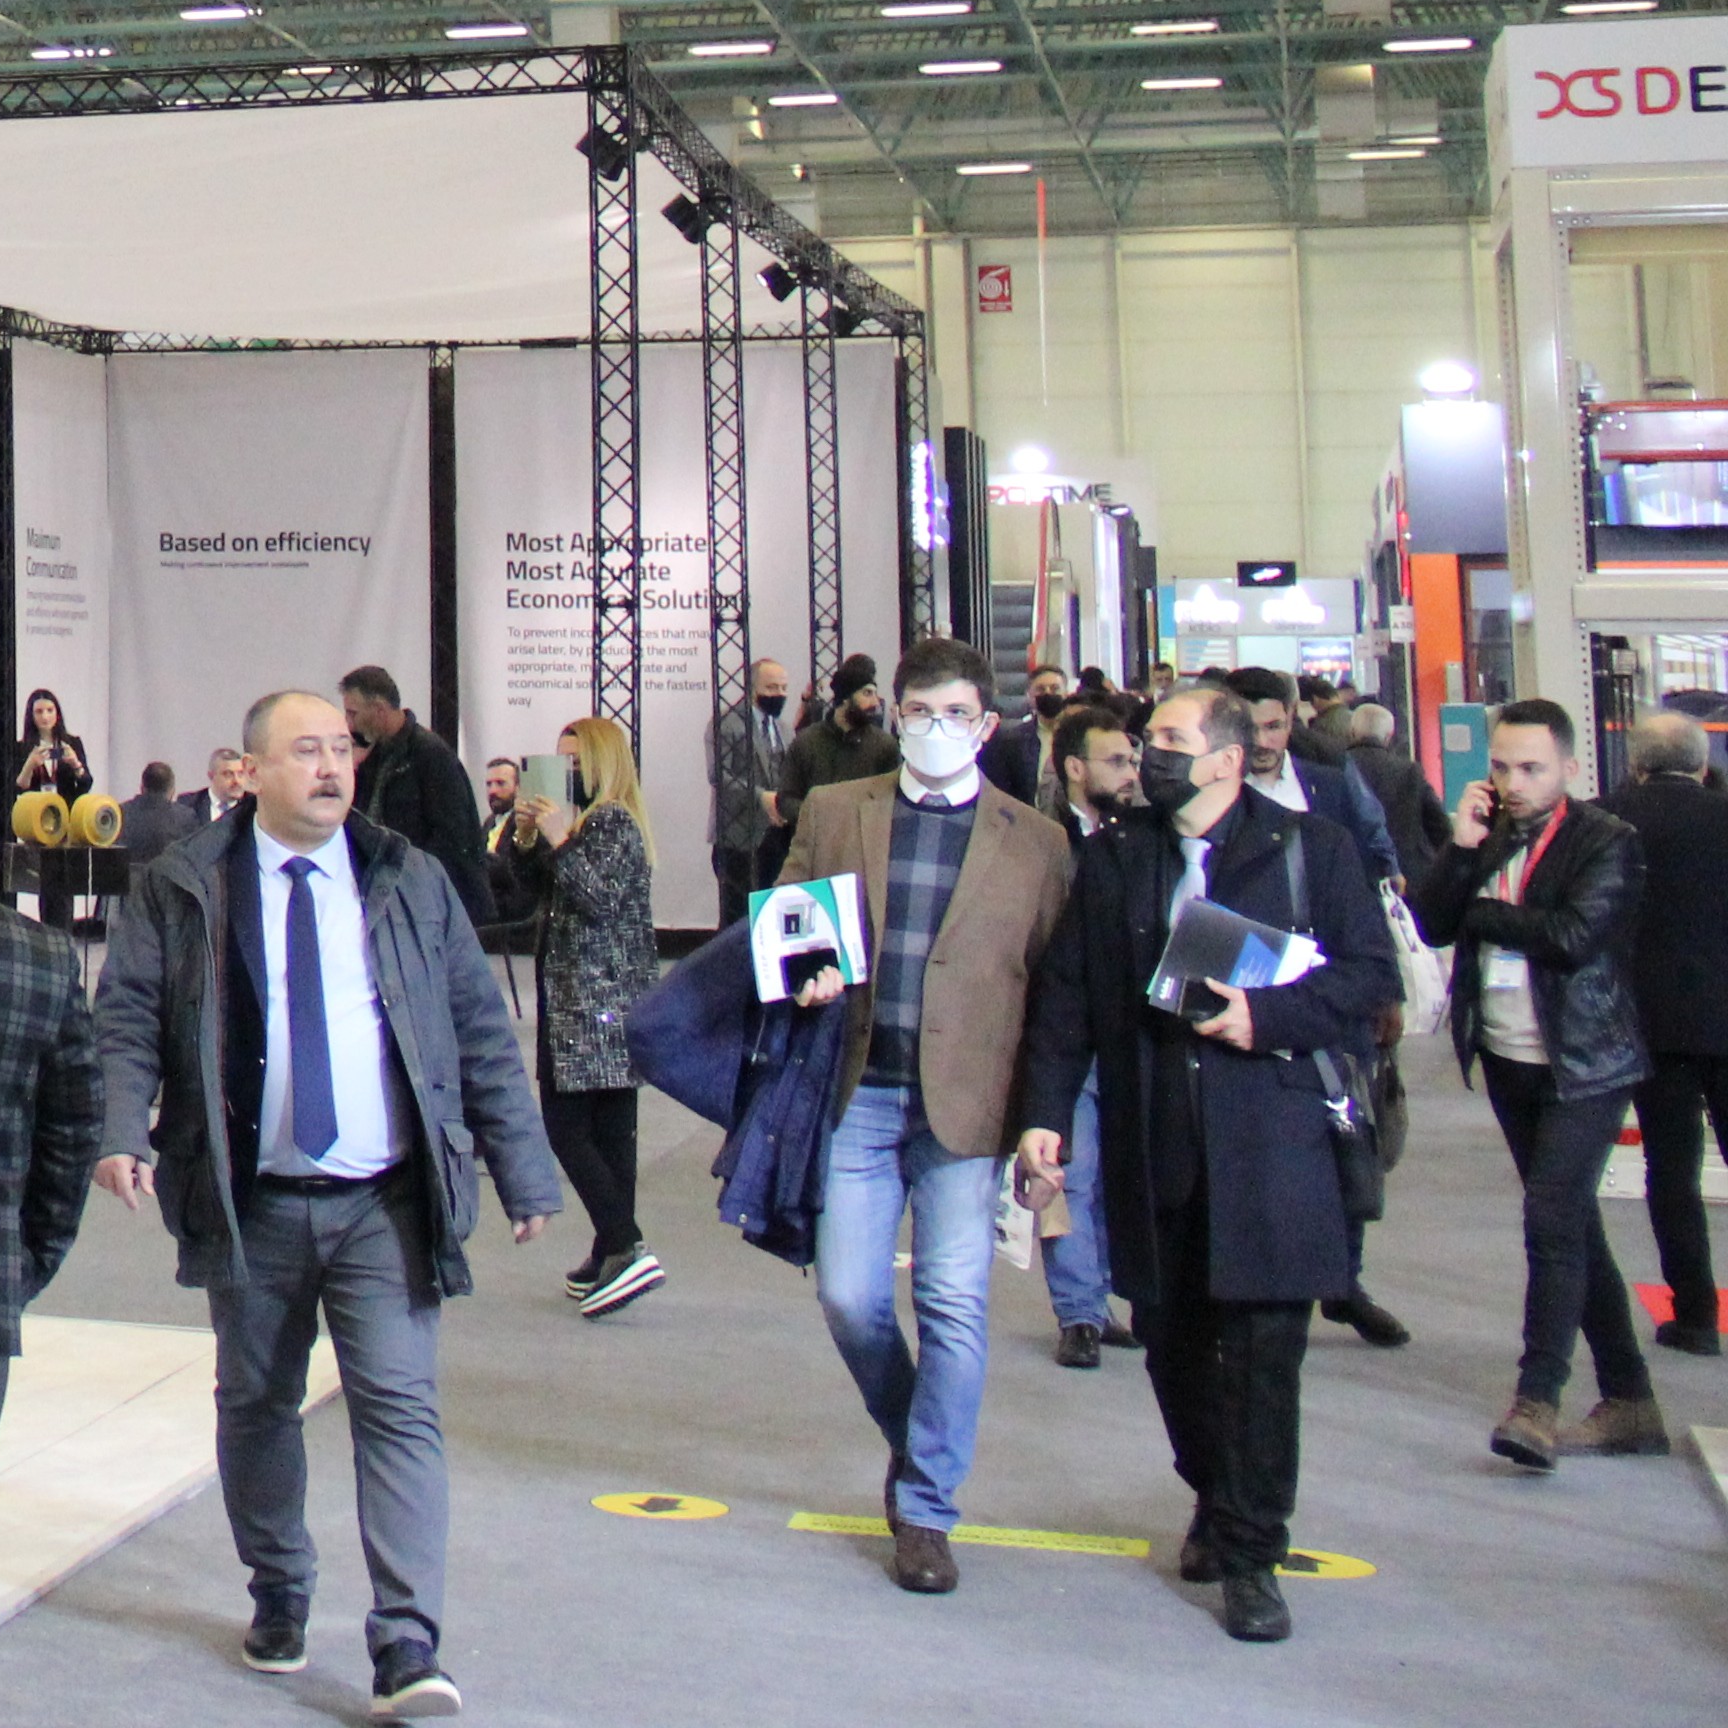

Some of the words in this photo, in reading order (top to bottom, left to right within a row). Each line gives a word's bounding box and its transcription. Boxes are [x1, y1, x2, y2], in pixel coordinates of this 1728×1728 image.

[159, 532, 225, 552] Based
[232, 536, 258, 552] on
[265, 531, 371, 557] efficiency
[506, 532, 564, 553] Most
[506, 560, 564, 581] Most
[507, 627, 520, 638] To
[523, 628, 567, 641] prevent
[661, 627, 685, 639] that
[507, 645, 535, 656] arise
[569, 645, 584, 658] by
[647, 646, 665, 656] the
[668, 647, 698, 657] most
[666, 662, 687, 673] and
[507, 678, 573, 690] economical
[645, 679, 663, 690] the
[666, 679, 707, 691] fastest
[507, 697, 532, 708] way
